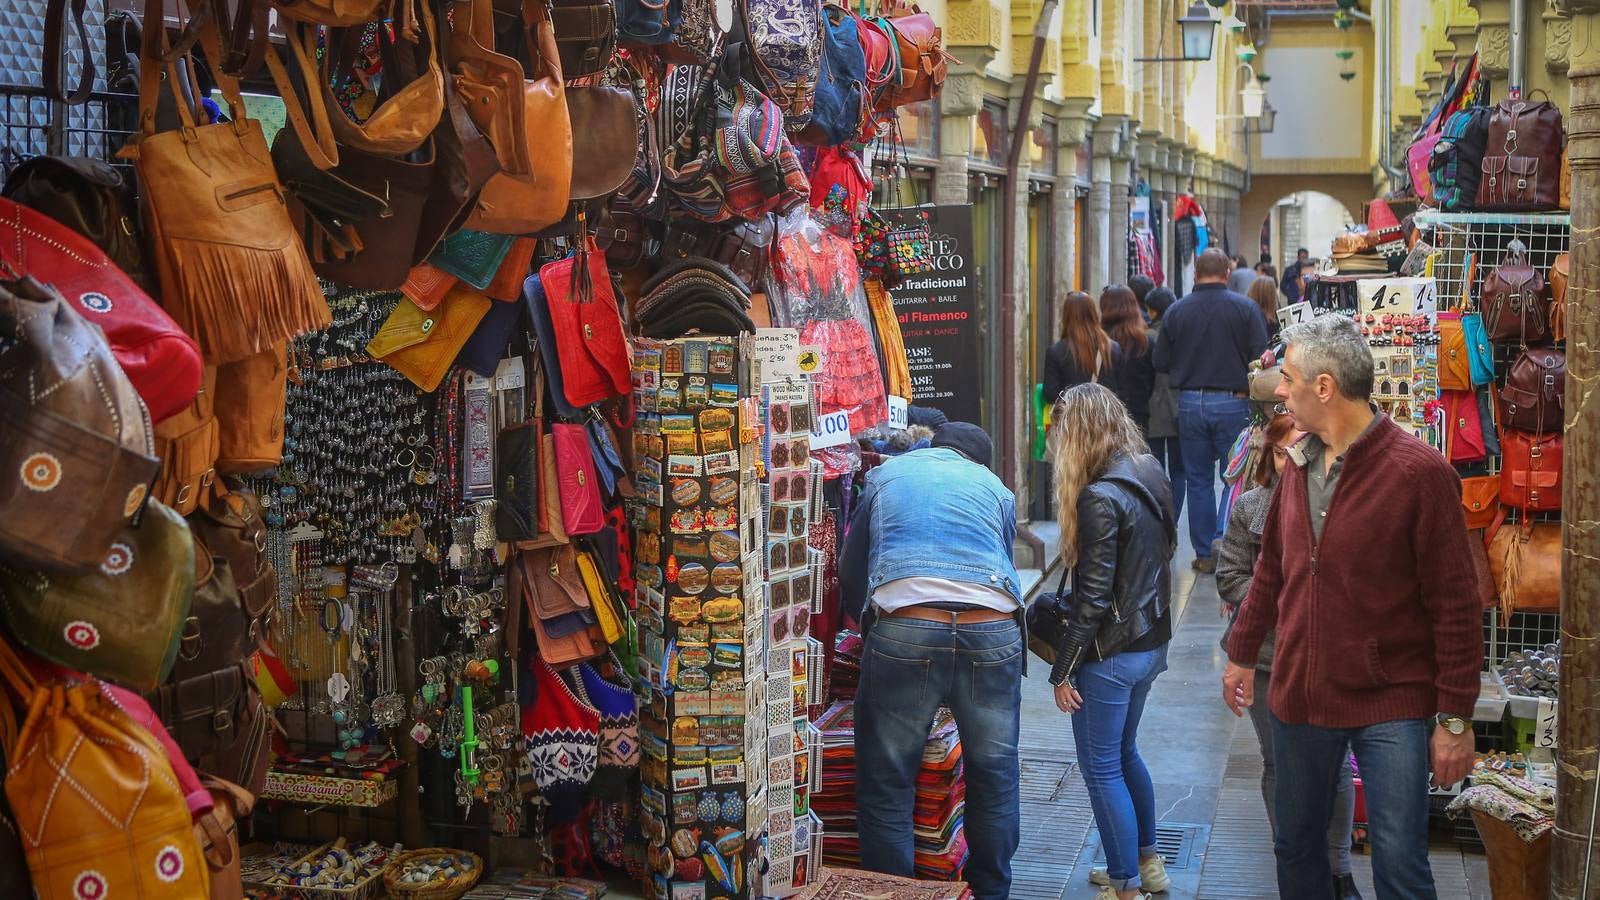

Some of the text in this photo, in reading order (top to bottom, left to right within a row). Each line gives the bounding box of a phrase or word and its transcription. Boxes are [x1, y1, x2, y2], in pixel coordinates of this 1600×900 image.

[928, 240, 951, 255] TE
[906, 276, 967, 290] Tradicional
[893, 294, 958, 306] GUITARRA BAILE
[899, 311, 968, 323] al Flamenco
[903, 328, 960, 338] UITAR DANCE
[911, 376, 933, 386] ASE
[786, 385, 806, 393] MAGNETS
[292, 783, 345, 796] artisanal
